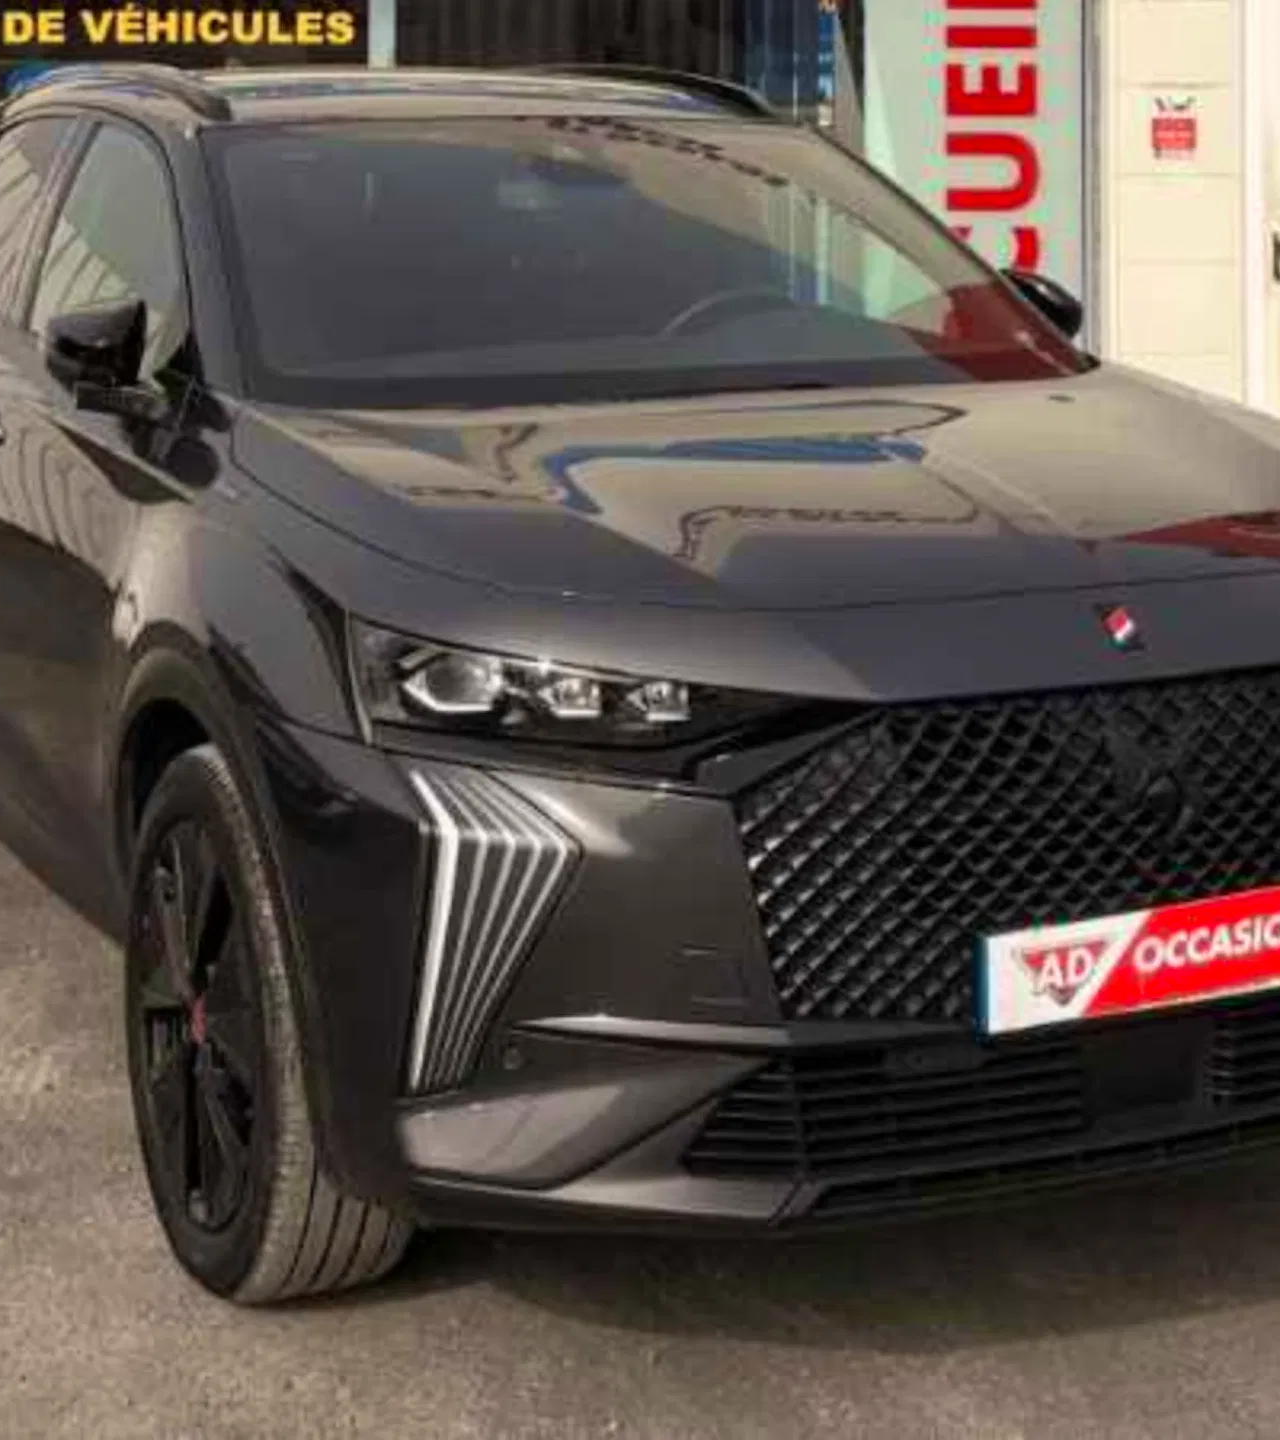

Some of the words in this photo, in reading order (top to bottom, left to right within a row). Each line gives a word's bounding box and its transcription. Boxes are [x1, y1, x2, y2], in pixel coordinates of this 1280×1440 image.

[1, 12, 65, 44] DE
[83, 3, 355, 45] VÉHICULES
[1032, 947, 1094, 994] AD
